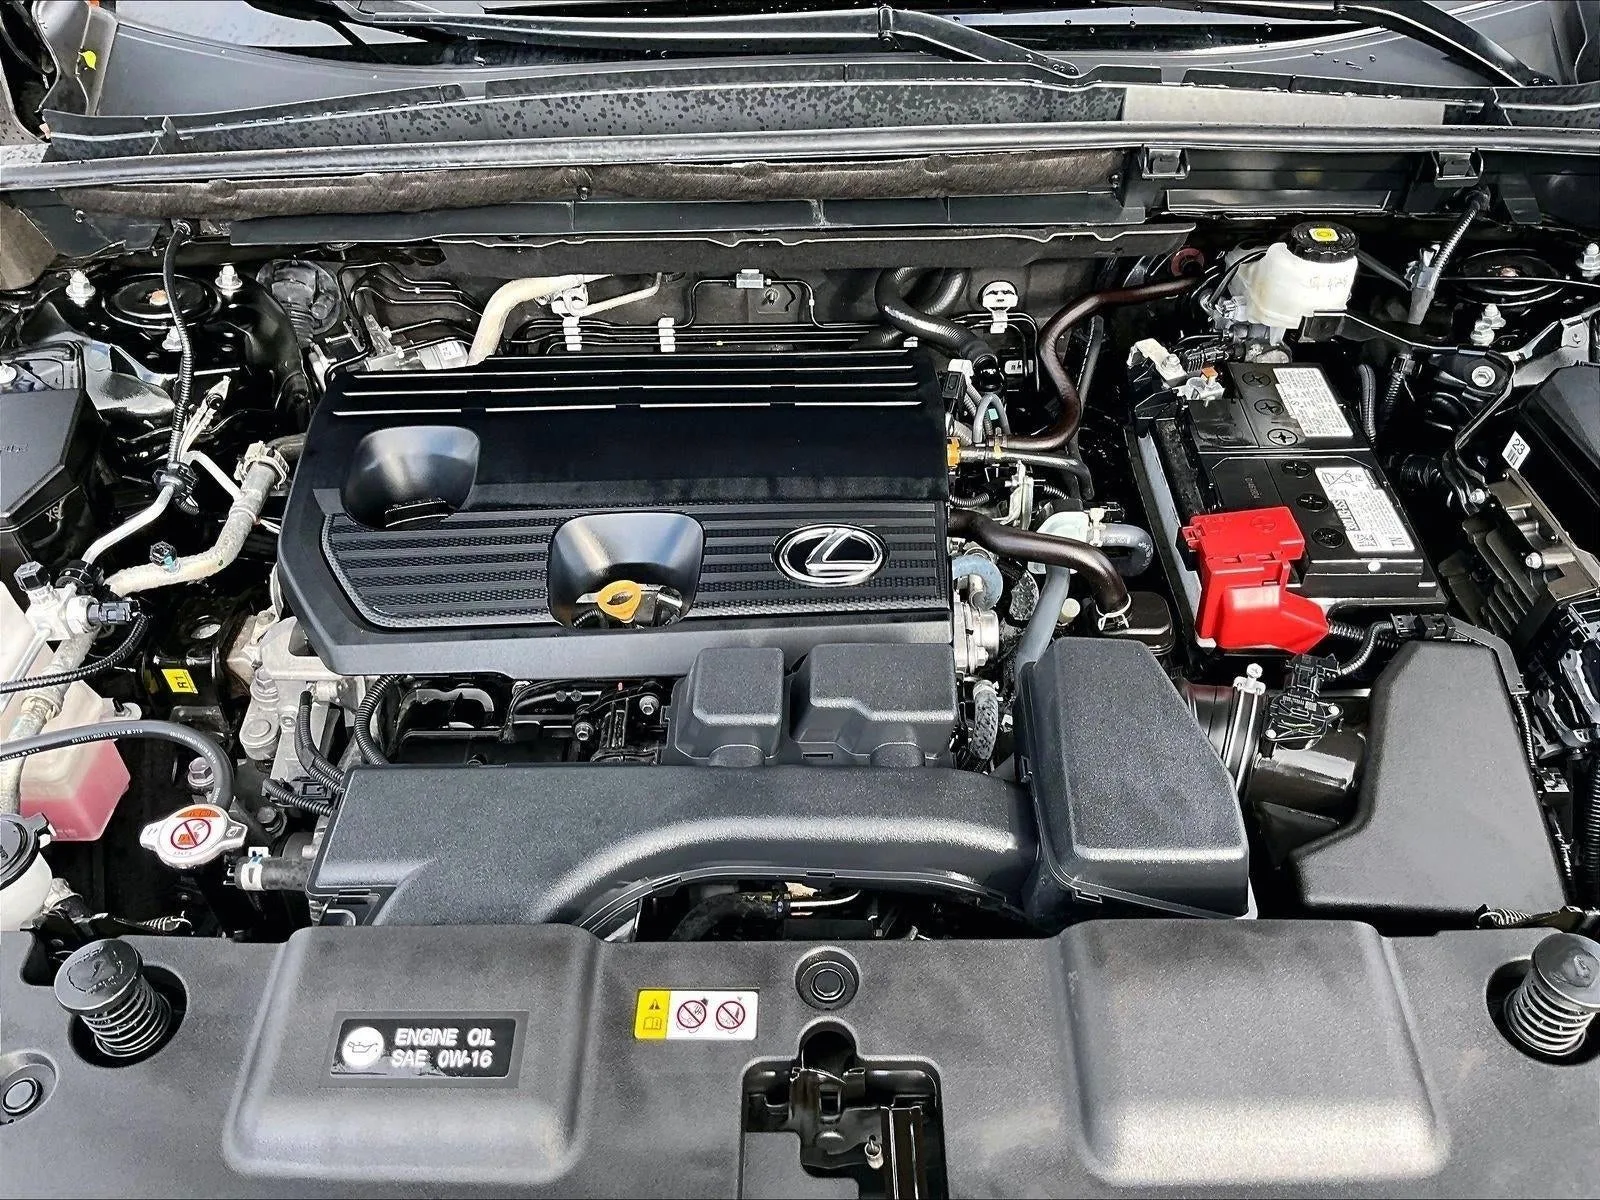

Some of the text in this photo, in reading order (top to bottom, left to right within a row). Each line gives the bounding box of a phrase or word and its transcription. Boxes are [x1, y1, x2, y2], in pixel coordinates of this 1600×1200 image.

[1512, 438, 1526, 456] 23
[394, 1027, 496, 1047] ENGINE OIL
[391, 1049, 493, 1068] SAE 0W-16
